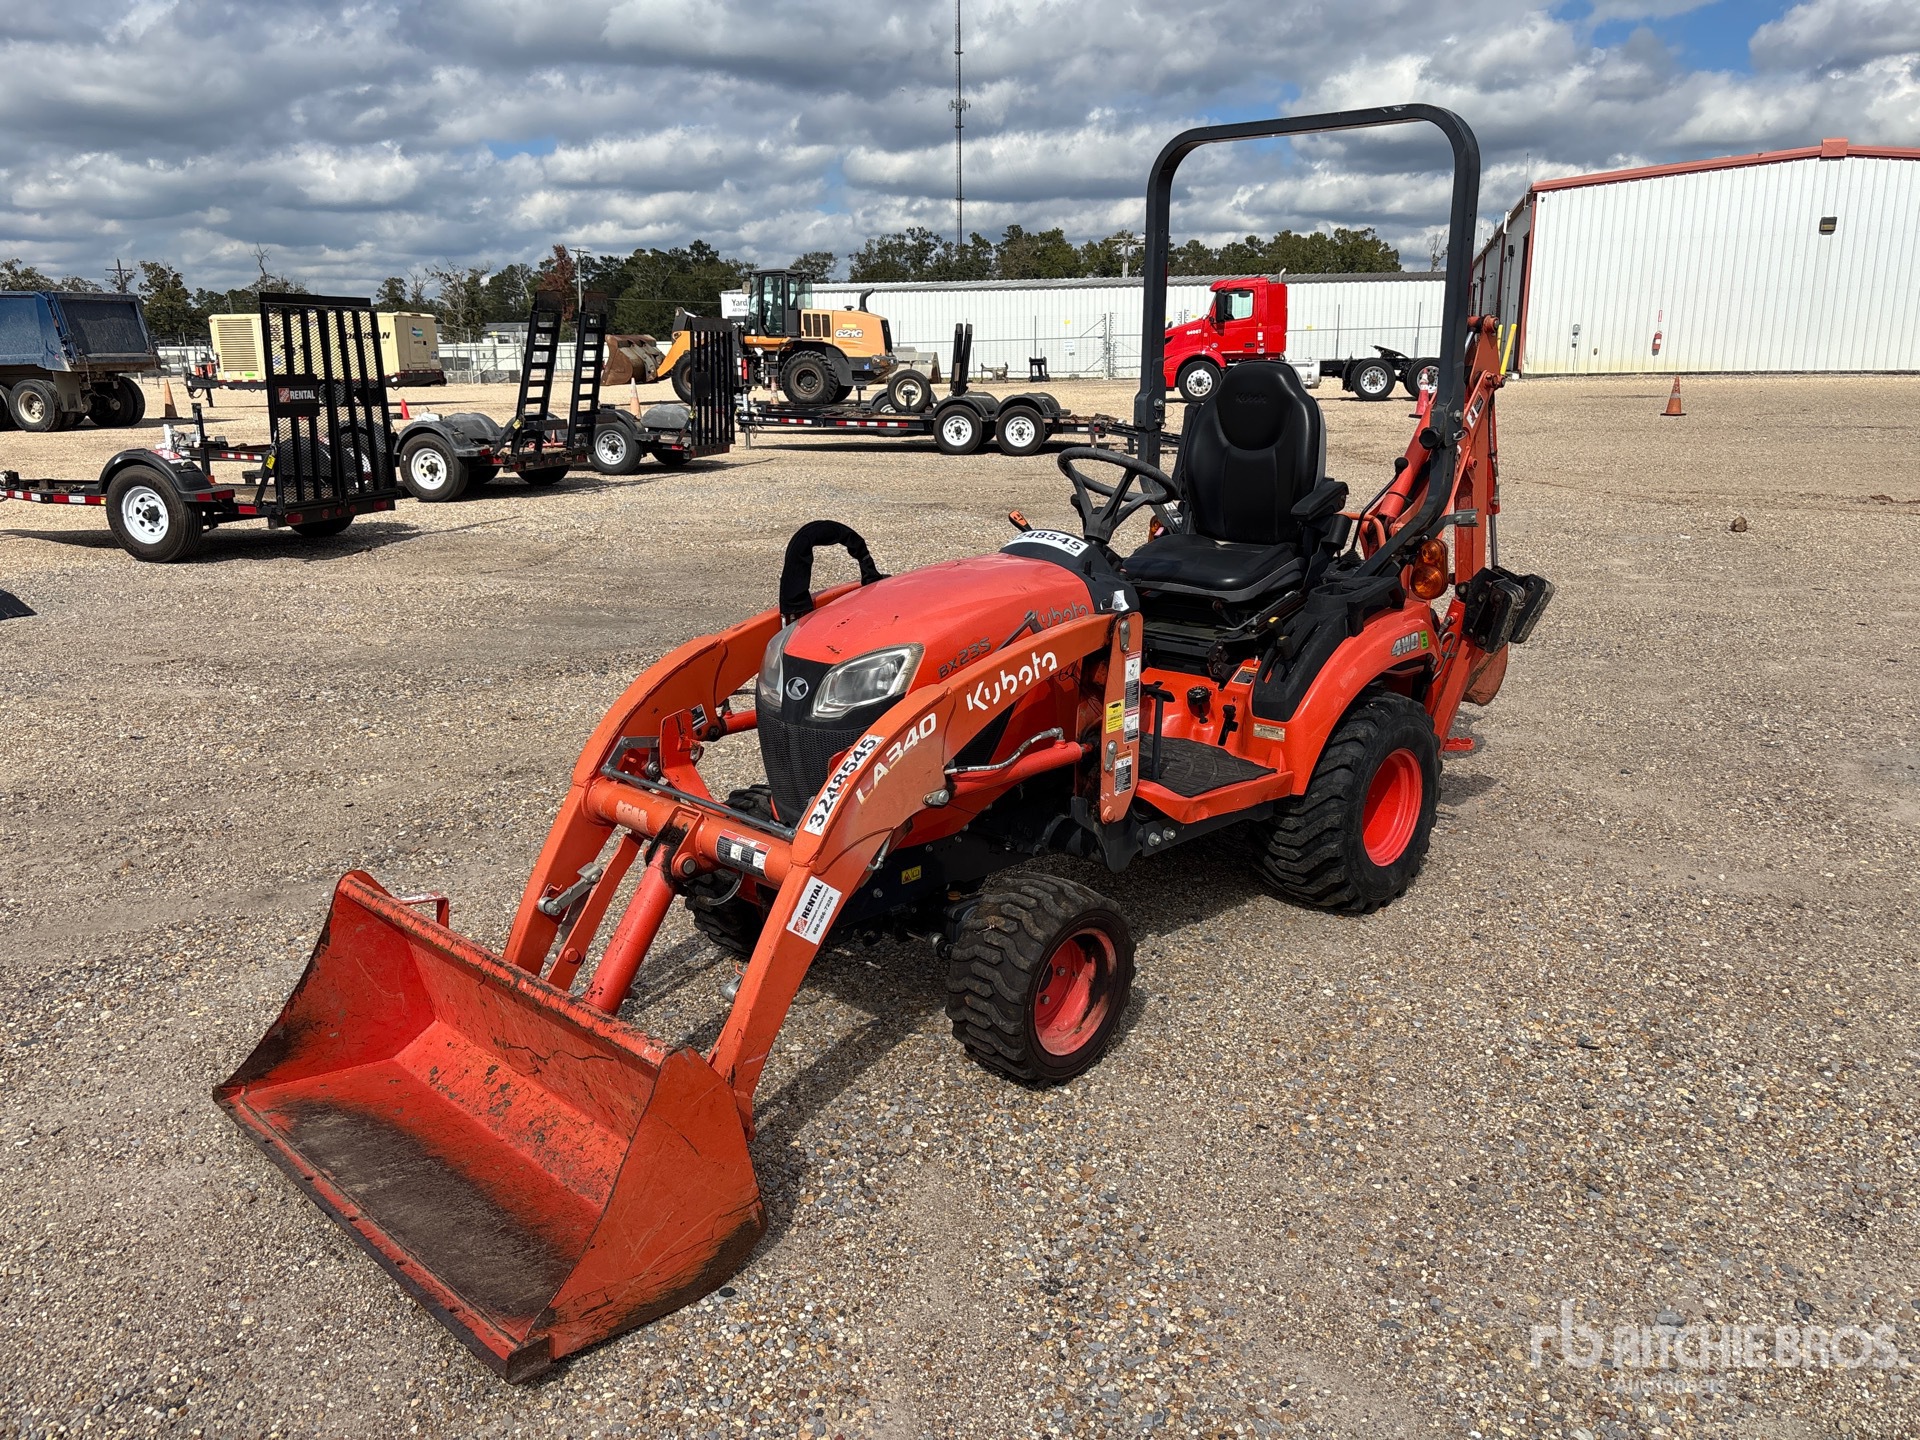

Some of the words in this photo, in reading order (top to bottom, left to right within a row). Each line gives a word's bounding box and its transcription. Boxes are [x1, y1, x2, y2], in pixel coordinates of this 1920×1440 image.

[836, 329, 863, 338] 621G
[290, 390, 316, 400] RENTAL
[1024, 602, 1089, 633] Kubota
[938, 637, 992, 679] BX23S
[1391, 631, 1419, 657] 4WD
[966, 651, 1058, 711] Kubota
[856, 712, 937, 805] LA340
[809, 738, 877, 827] 3248545
[801, 884, 824, 919] RENTAL
